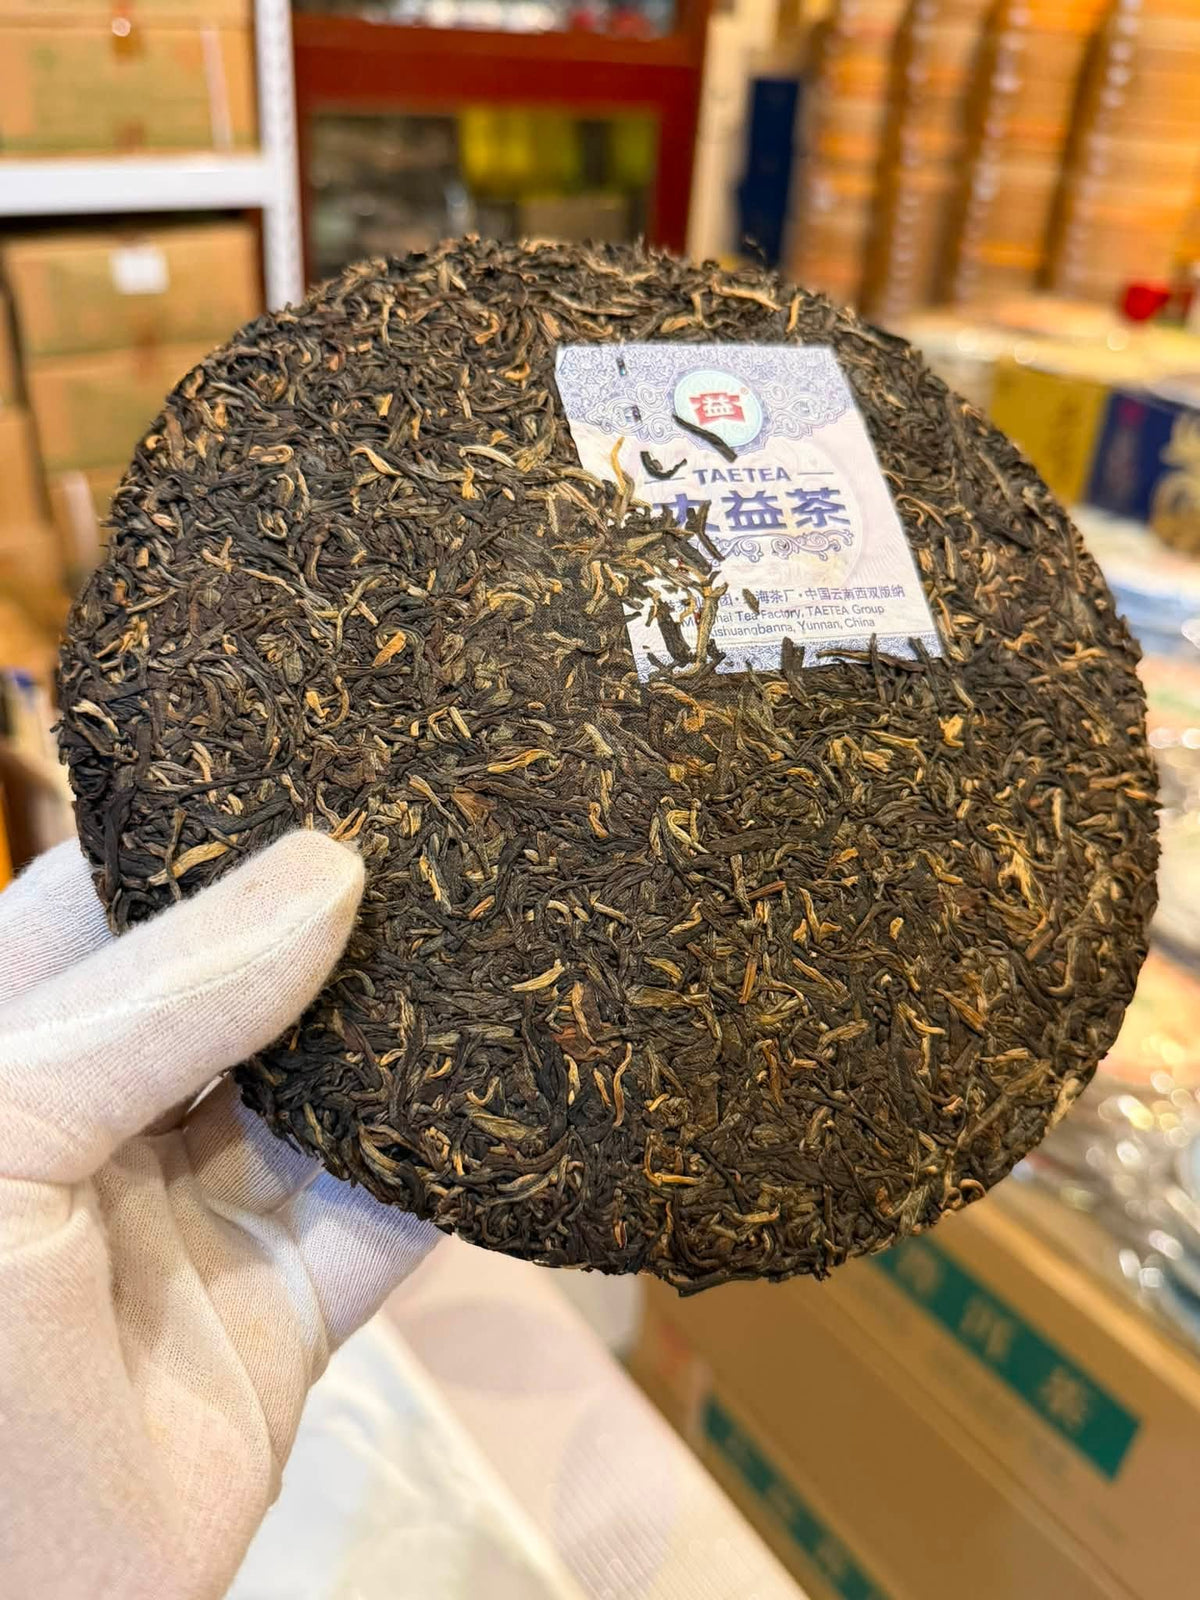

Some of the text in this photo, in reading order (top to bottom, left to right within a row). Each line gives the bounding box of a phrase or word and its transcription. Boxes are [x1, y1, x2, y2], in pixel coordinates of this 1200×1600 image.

[693, 467, 792, 484] TAETEA
[735, 611, 758, 622] Tea
[806, 606, 849, 616] TAETEA
[852, 604, 884, 616] Group
[797, 619, 843, 633] Yunnan,
[844, 617, 875, 629] China
